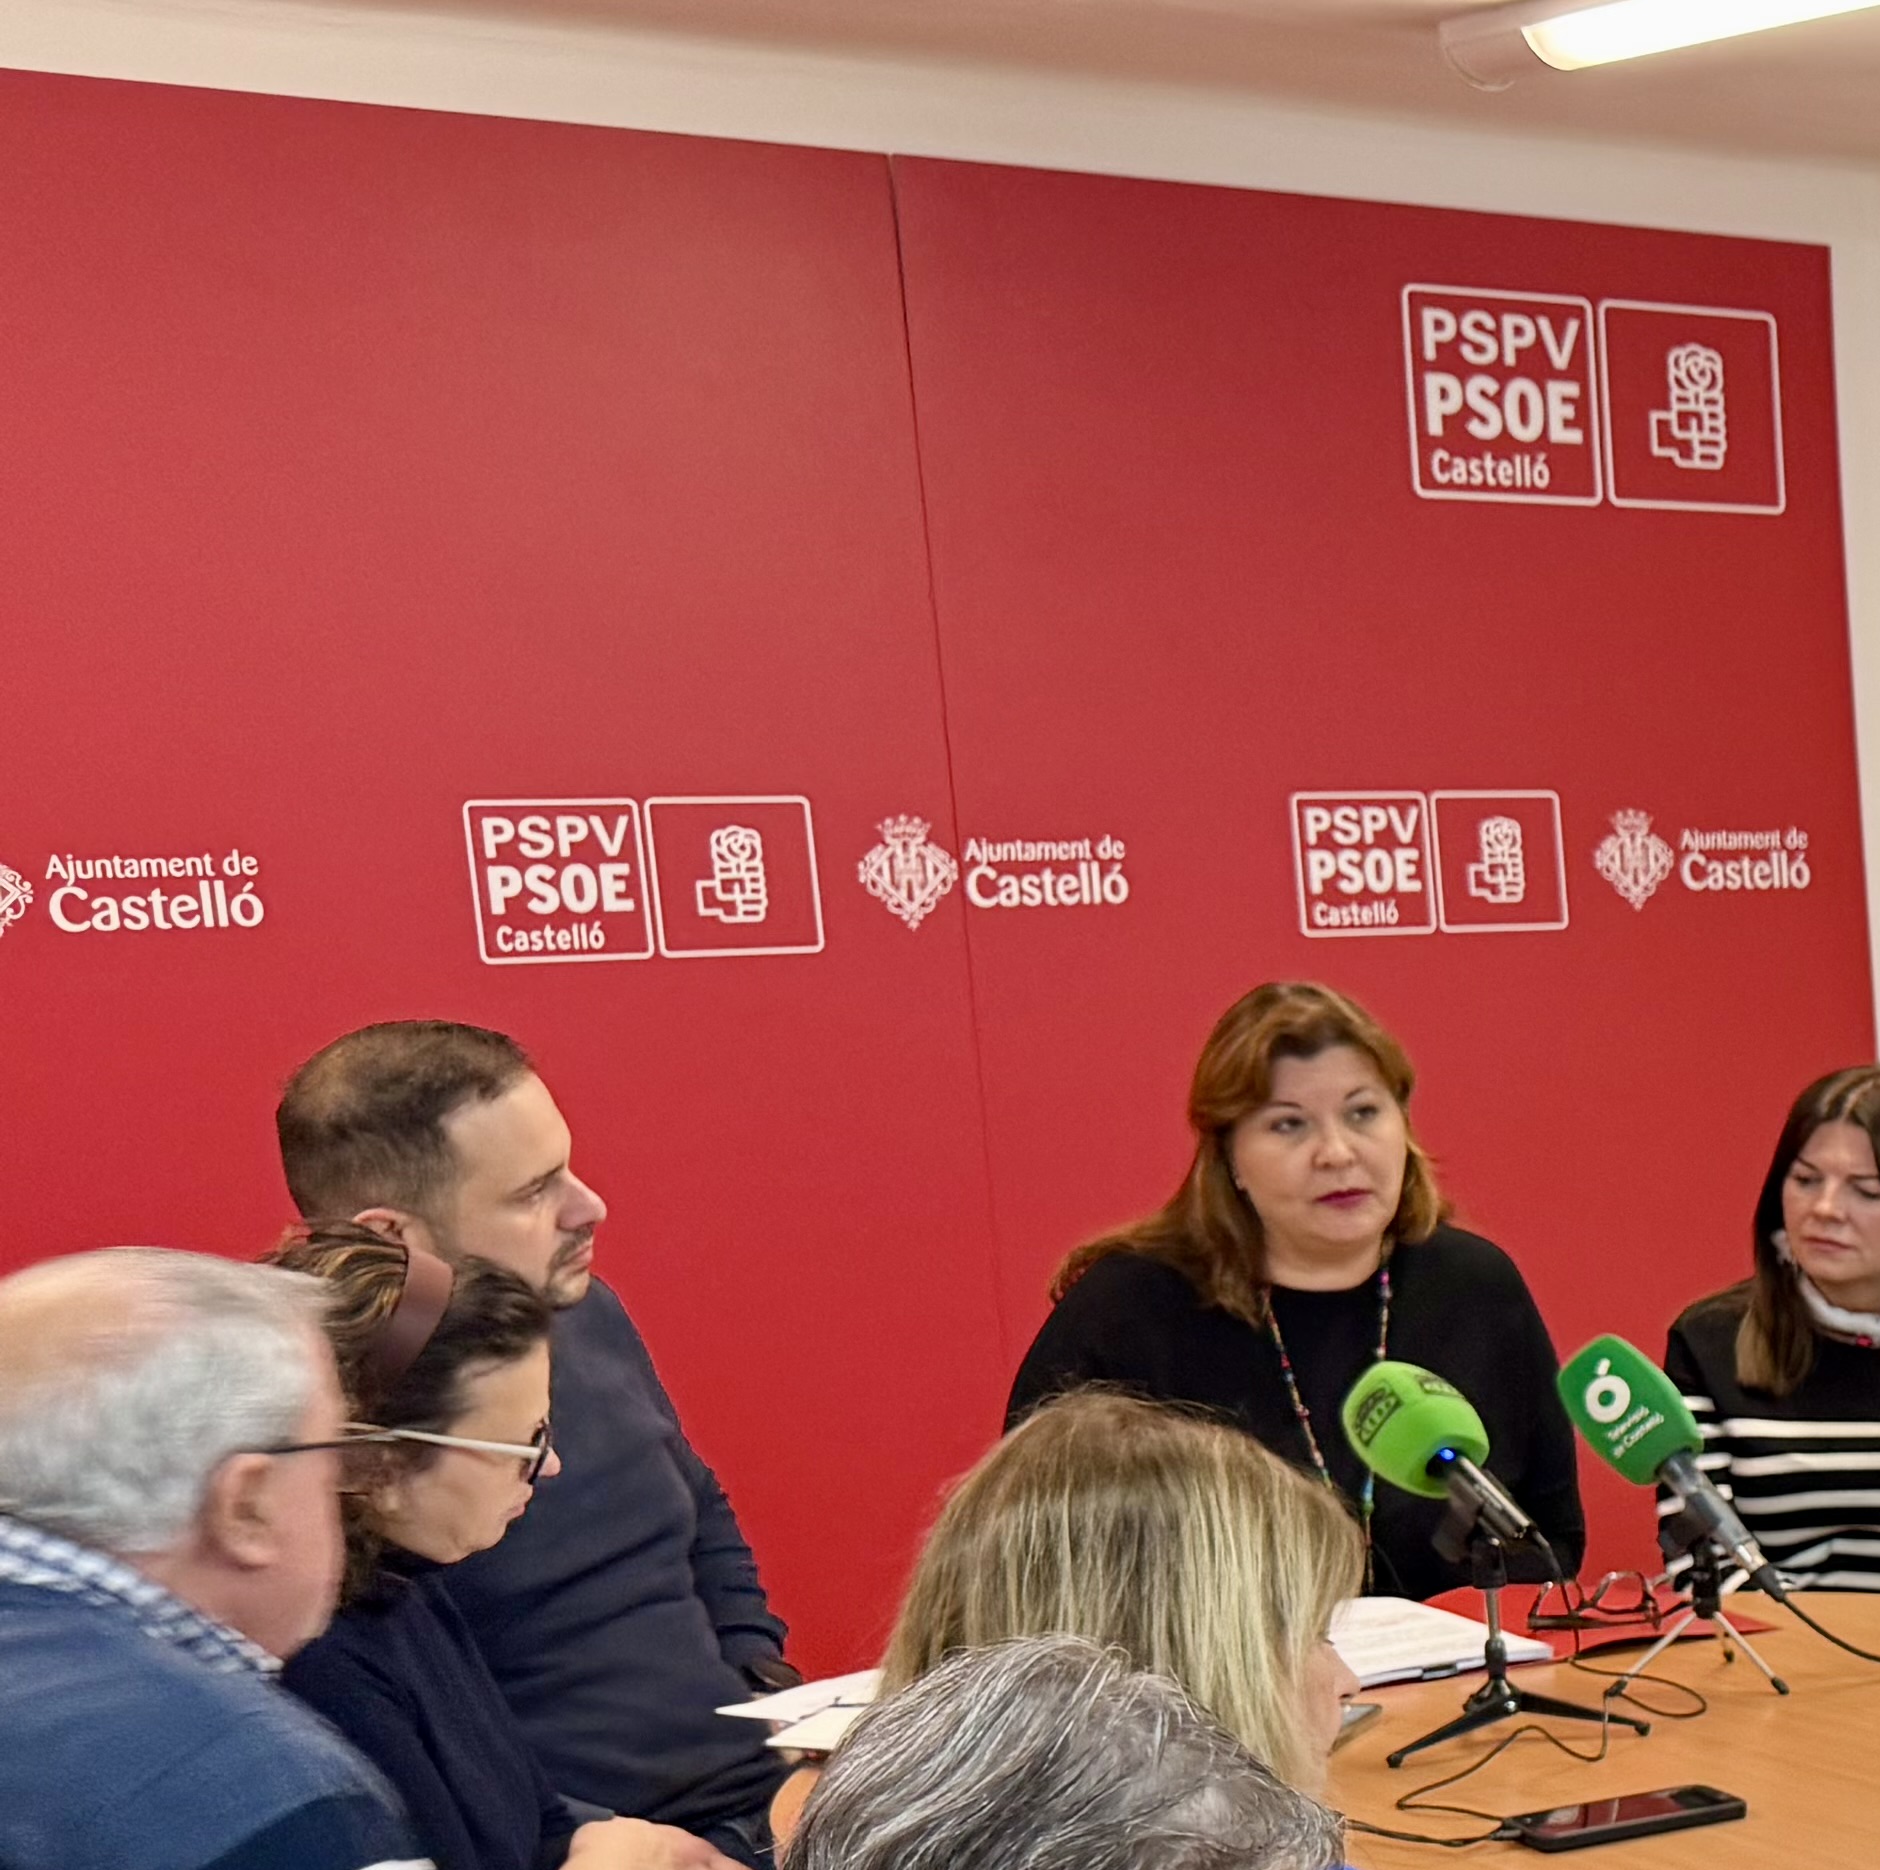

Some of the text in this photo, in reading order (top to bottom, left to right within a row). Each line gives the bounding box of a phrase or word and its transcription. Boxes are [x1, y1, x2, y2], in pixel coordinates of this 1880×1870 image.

[1421, 307, 1580, 370] PSPV
[1423, 372, 1584, 445] PSOE
[1431, 448, 1550, 489] Castelló
[481, 814, 629, 859] PSPV
[1304, 806, 1419, 846] PSPV
[1680, 825, 1808, 852] Ajuntament de
[45, 848, 259, 886] Ajuntament de
[964, 834, 1126, 865] Ajuntament de
[1681, 849, 1811, 891] Castelló
[486, 862, 635, 915] PSOE
[965, 861, 1129, 908] Castelló
[1308, 847, 1423, 895] PSOE
[48, 879, 265, 933] Castelló
[1313, 898, 1399, 927] Castelló
[496, 920, 605, 953] Castelló
